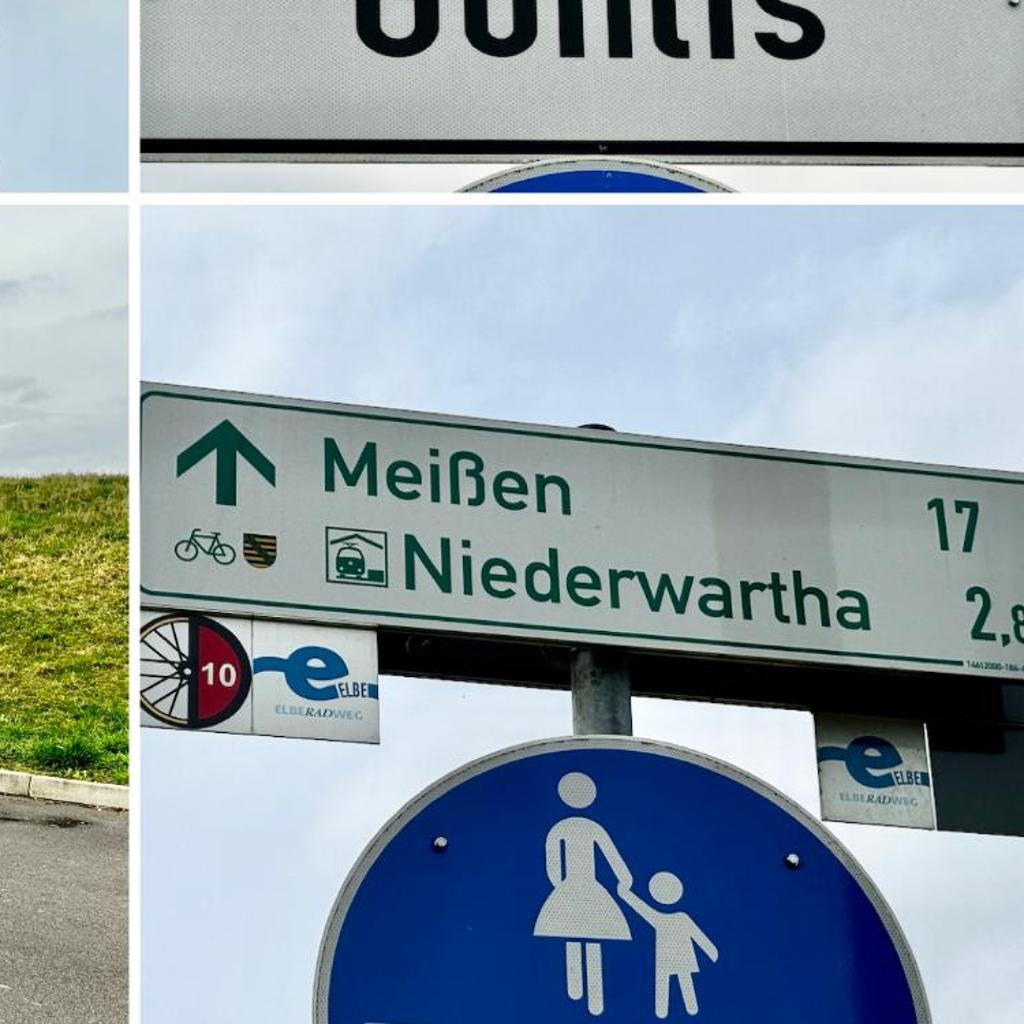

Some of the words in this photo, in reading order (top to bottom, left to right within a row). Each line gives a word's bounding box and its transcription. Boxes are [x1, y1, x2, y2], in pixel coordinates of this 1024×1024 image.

[323, 437, 572, 516] Meißen
[926, 497, 980, 554] 17
[403, 533, 872, 632] Niederwartha
[201, 662, 237, 687] 10
[338, 682, 368, 698] ELBE
[274, 704, 363, 721] ELBERADWEG
[894, 771, 921, 786] ELBE
[839, 792, 919, 808] ELBERADWEG
